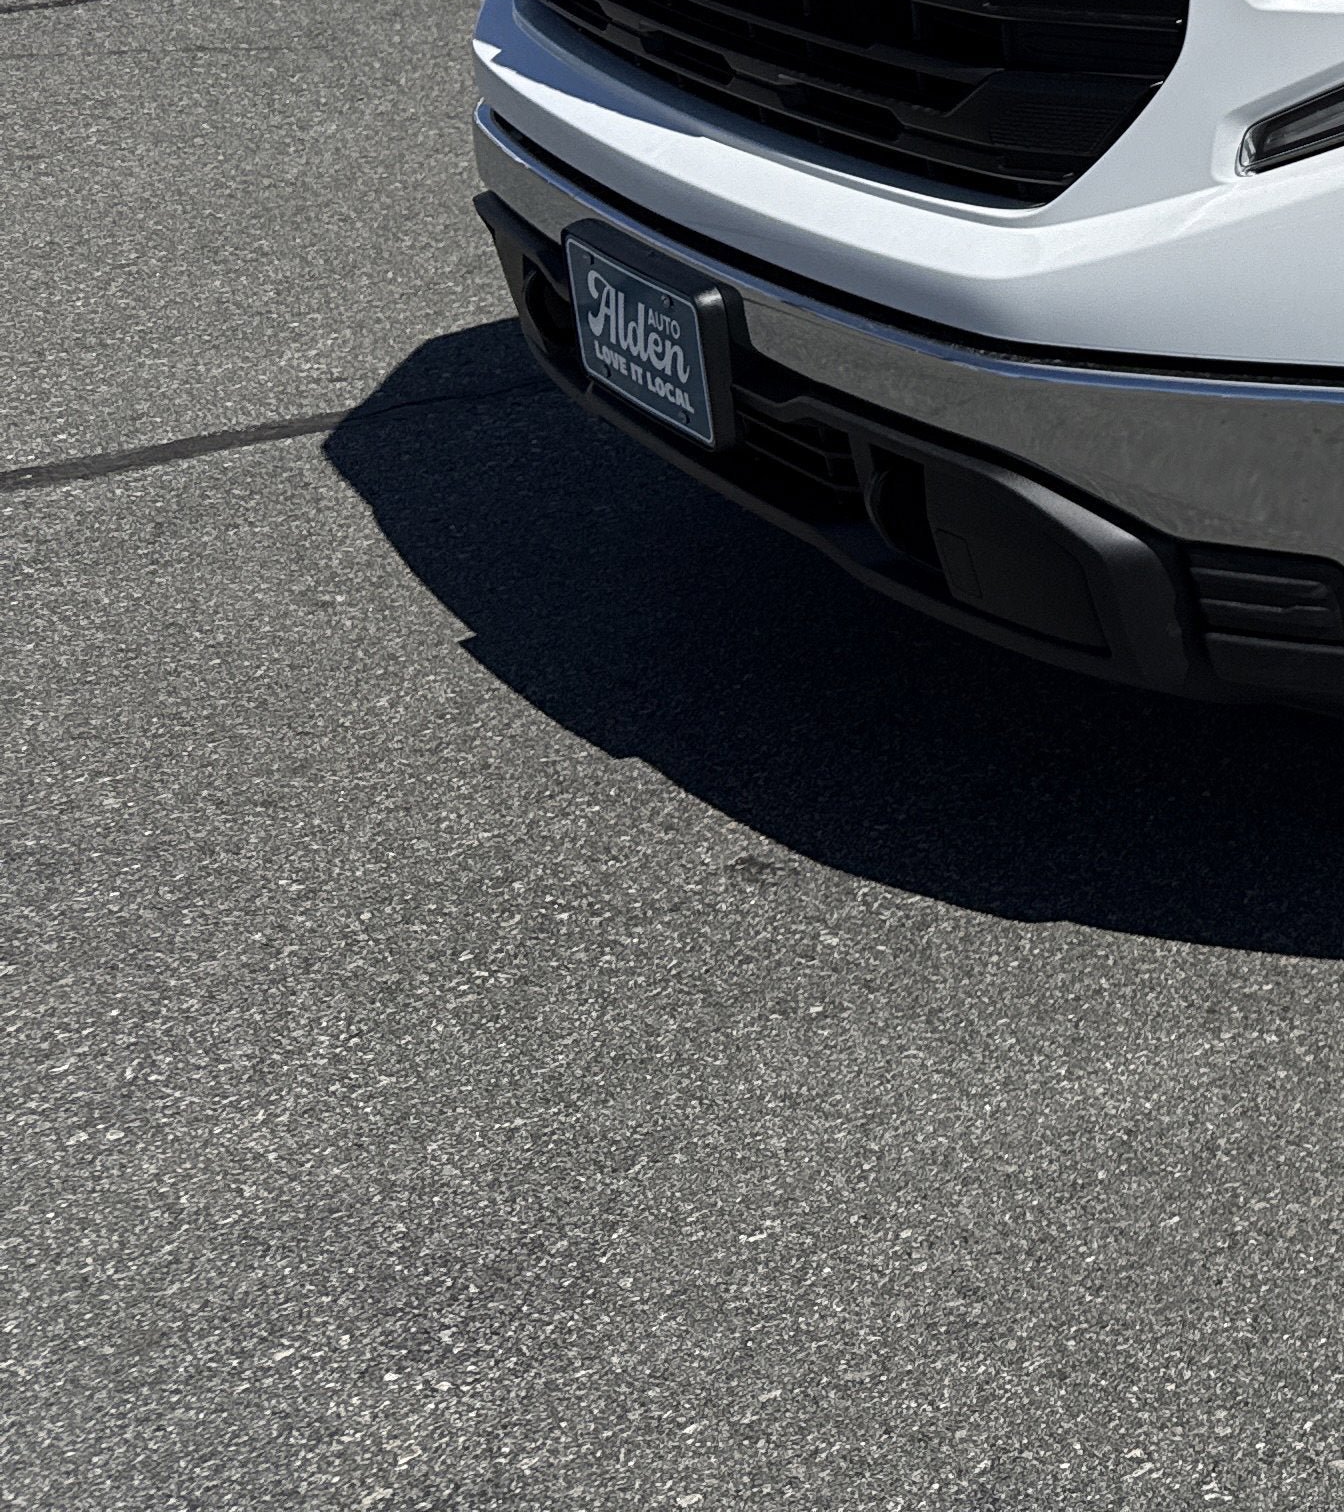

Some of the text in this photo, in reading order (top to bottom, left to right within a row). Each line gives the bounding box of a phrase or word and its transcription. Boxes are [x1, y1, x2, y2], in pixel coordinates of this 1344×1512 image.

[587, 269, 690, 384] Alden
[648, 308, 681, 339] AUTO
[594, 340, 695, 414] LOVE IT LOCAL
